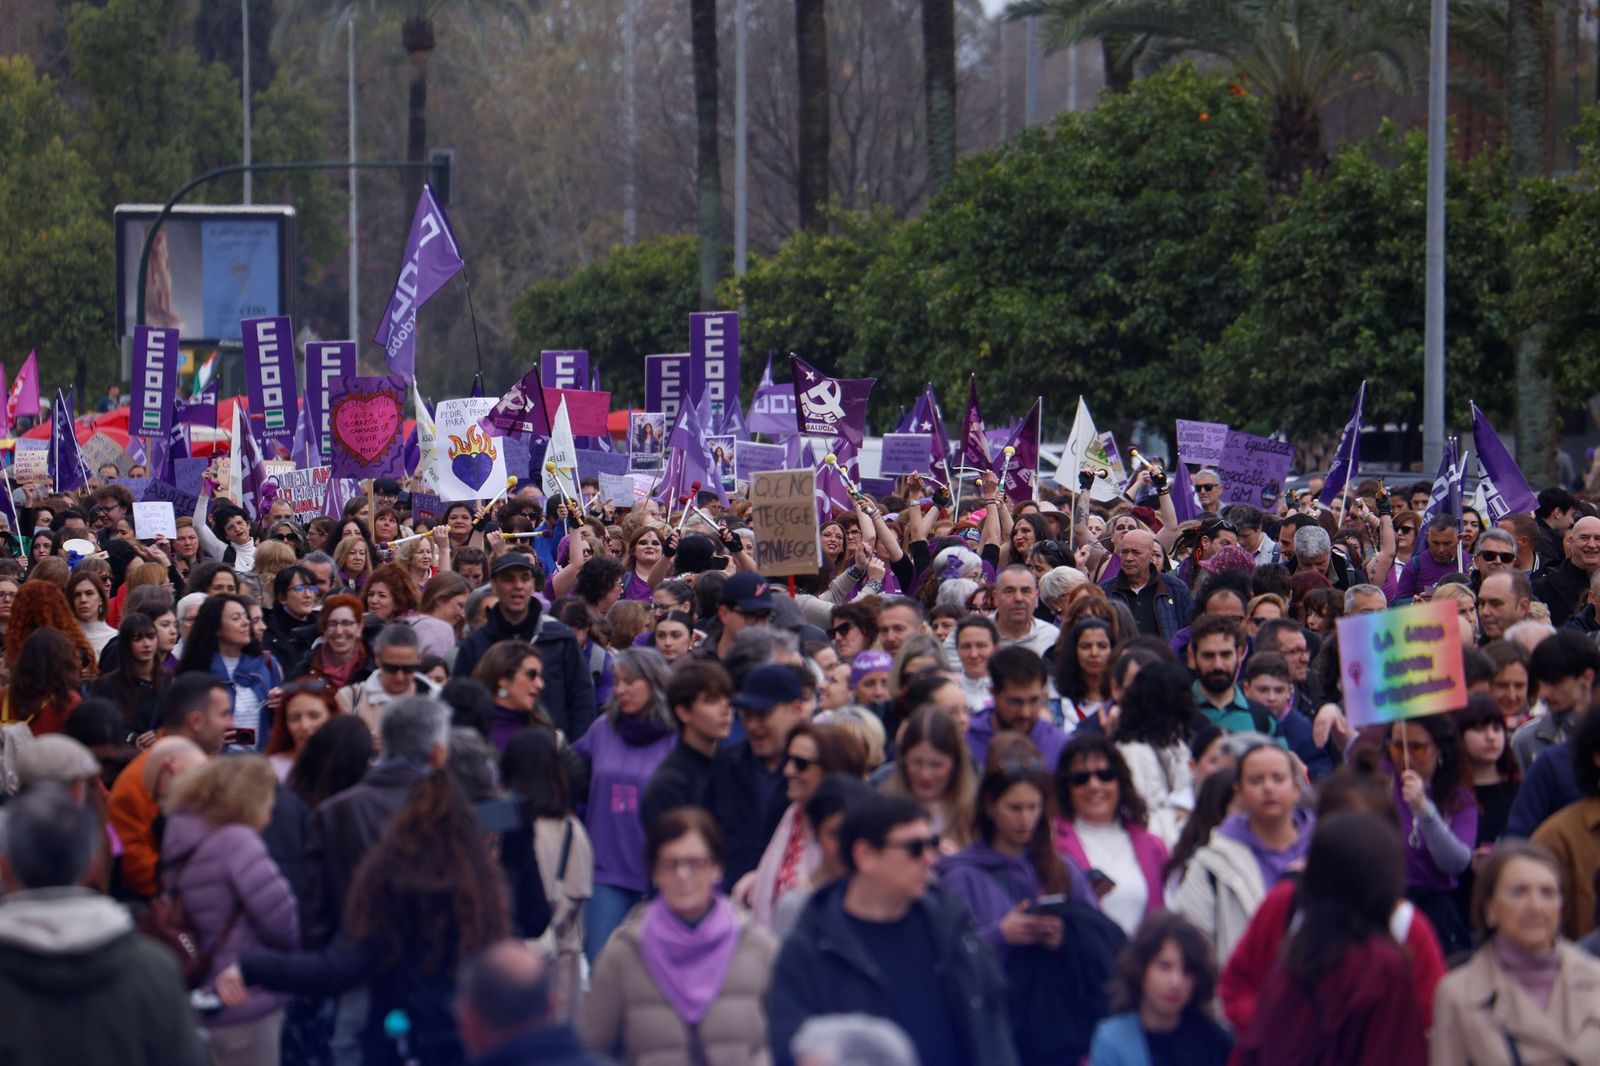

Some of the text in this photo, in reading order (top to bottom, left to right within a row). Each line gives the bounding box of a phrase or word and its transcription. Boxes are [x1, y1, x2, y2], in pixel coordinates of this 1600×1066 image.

[256, 321, 284, 408] CCOO
[705, 317, 724, 399] CCOO
[144, 330, 165, 409] CCOO
[445, 401, 457, 410] NO
[462, 400, 478, 408] VOY
[440, 409, 463, 419] PEDIR
[445, 417, 466, 428] PARA
[138, 428, 164, 437] Córdoba
[262, 428, 291, 437] Córdoba
[1244, 436, 1291, 457] igualdad
[754, 476, 785, 498] QUE
[788, 474, 813, 498] NO
